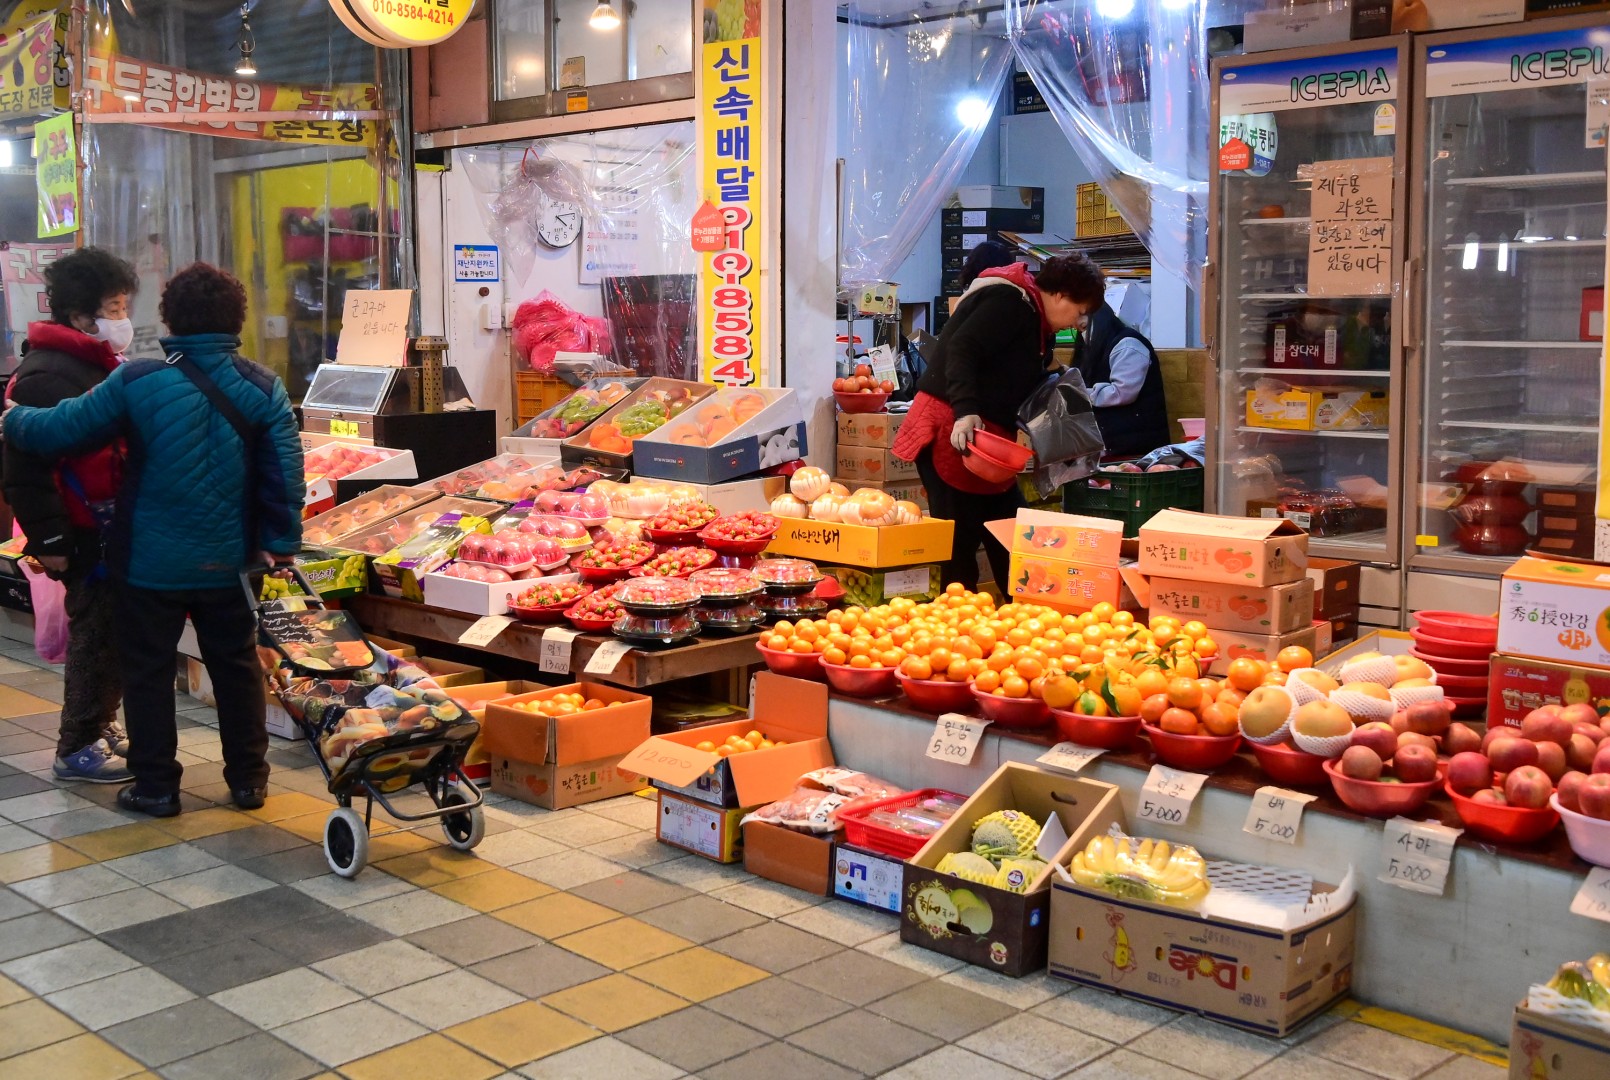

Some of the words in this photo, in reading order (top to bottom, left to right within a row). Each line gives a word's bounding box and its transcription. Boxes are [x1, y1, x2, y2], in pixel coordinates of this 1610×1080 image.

[372, 0, 454, 26] 010-8584-4214
[83, 56, 262, 132] 구두종합병원
[1290, 66, 1391, 103] ICEPIA
[28, 84, 53, 109] 전문
[712, 44, 755, 203] 신속배달
[457, 259, 495, 269] 재난지원카드
[1289, 343, 1320, 358] 참다래
[1145, 543, 1177, 562] 맛좋은
[1066, 578, 1096, 599] 감귤
[1156, 592, 1190, 609] 맛좋은
[1268, 796, 1286, 811] 배
[1168, 949, 1238, 991] Dole
